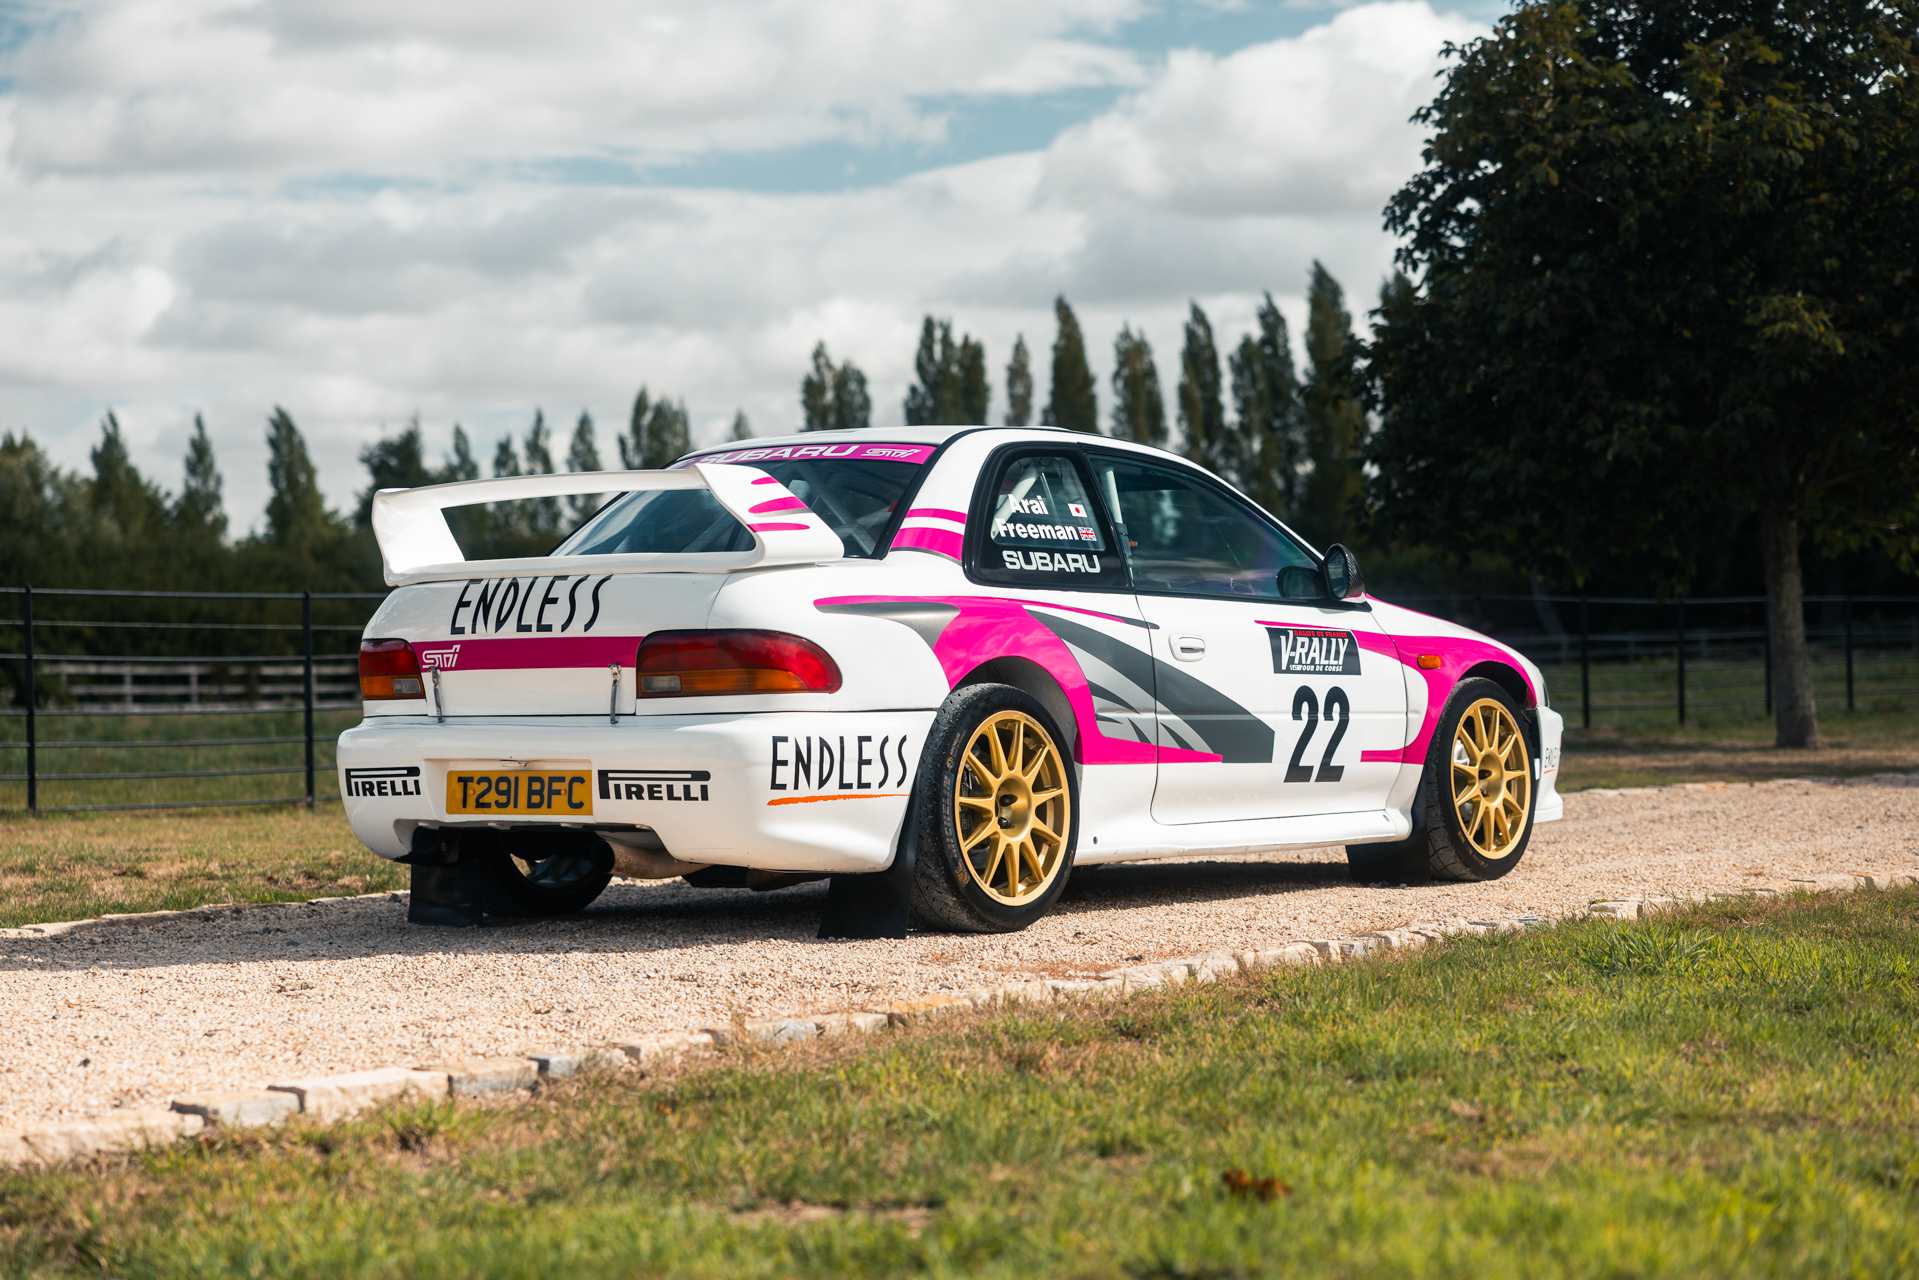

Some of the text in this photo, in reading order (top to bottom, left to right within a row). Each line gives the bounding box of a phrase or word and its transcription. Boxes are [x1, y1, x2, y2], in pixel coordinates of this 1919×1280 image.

[699, 444, 860, 464] SUBARU
[1007, 494, 1049, 515] Arai
[994, 518, 1079, 541] Freeman
[1002, 550, 1101, 573] SUBARU
[450, 574, 614, 635] ENDLESS
[1280, 630, 1349, 670] V-RALLY
[1284, 685, 1350, 783] 22
[770, 734, 908, 790] ENDLESS
[345, 766, 422, 797] PIRELLI
[457, 776, 586, 809] T291 BFC
[598, 769, 711, 801] PIRELLI
